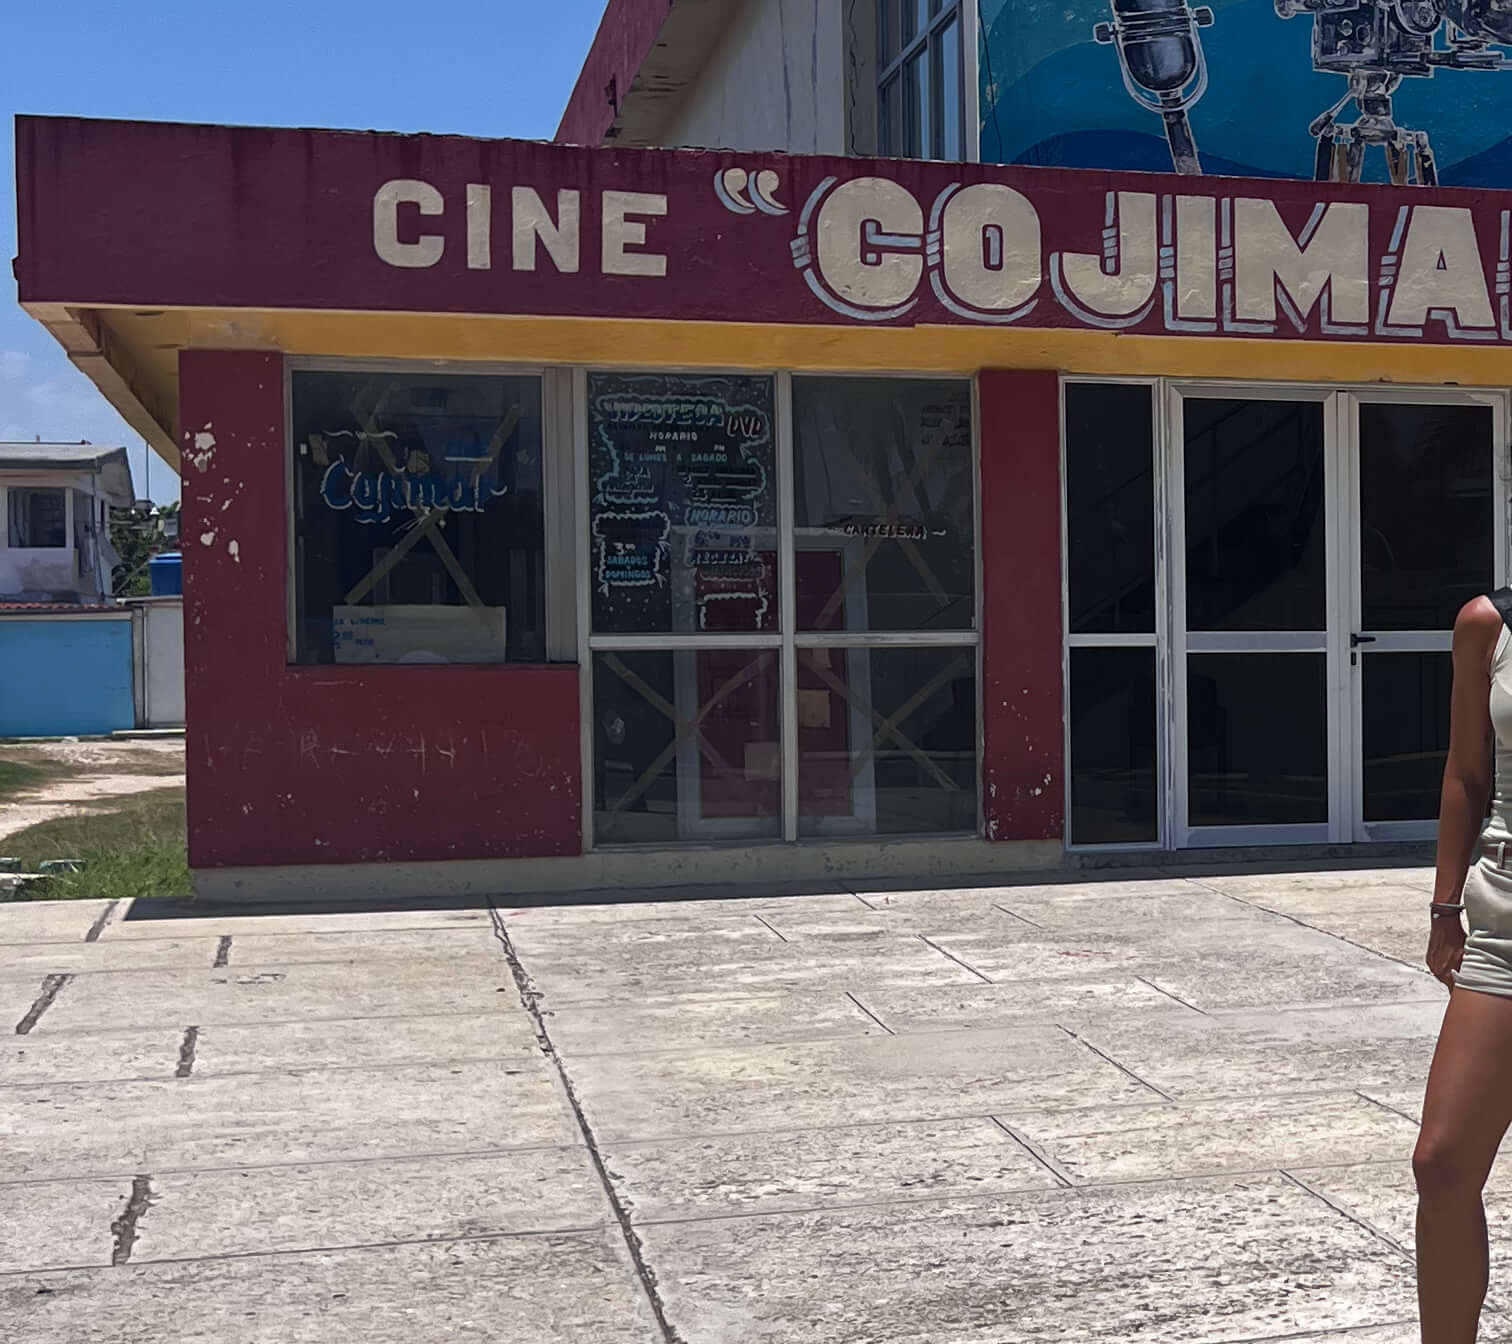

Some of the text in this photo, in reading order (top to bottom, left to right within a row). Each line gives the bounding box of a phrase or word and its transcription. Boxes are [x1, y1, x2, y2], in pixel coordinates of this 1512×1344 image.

[372, 179, 668, 276] CINE
[649, 431, 699, 441] HORARIO
[690, 509, 752, 523] HORARIO
